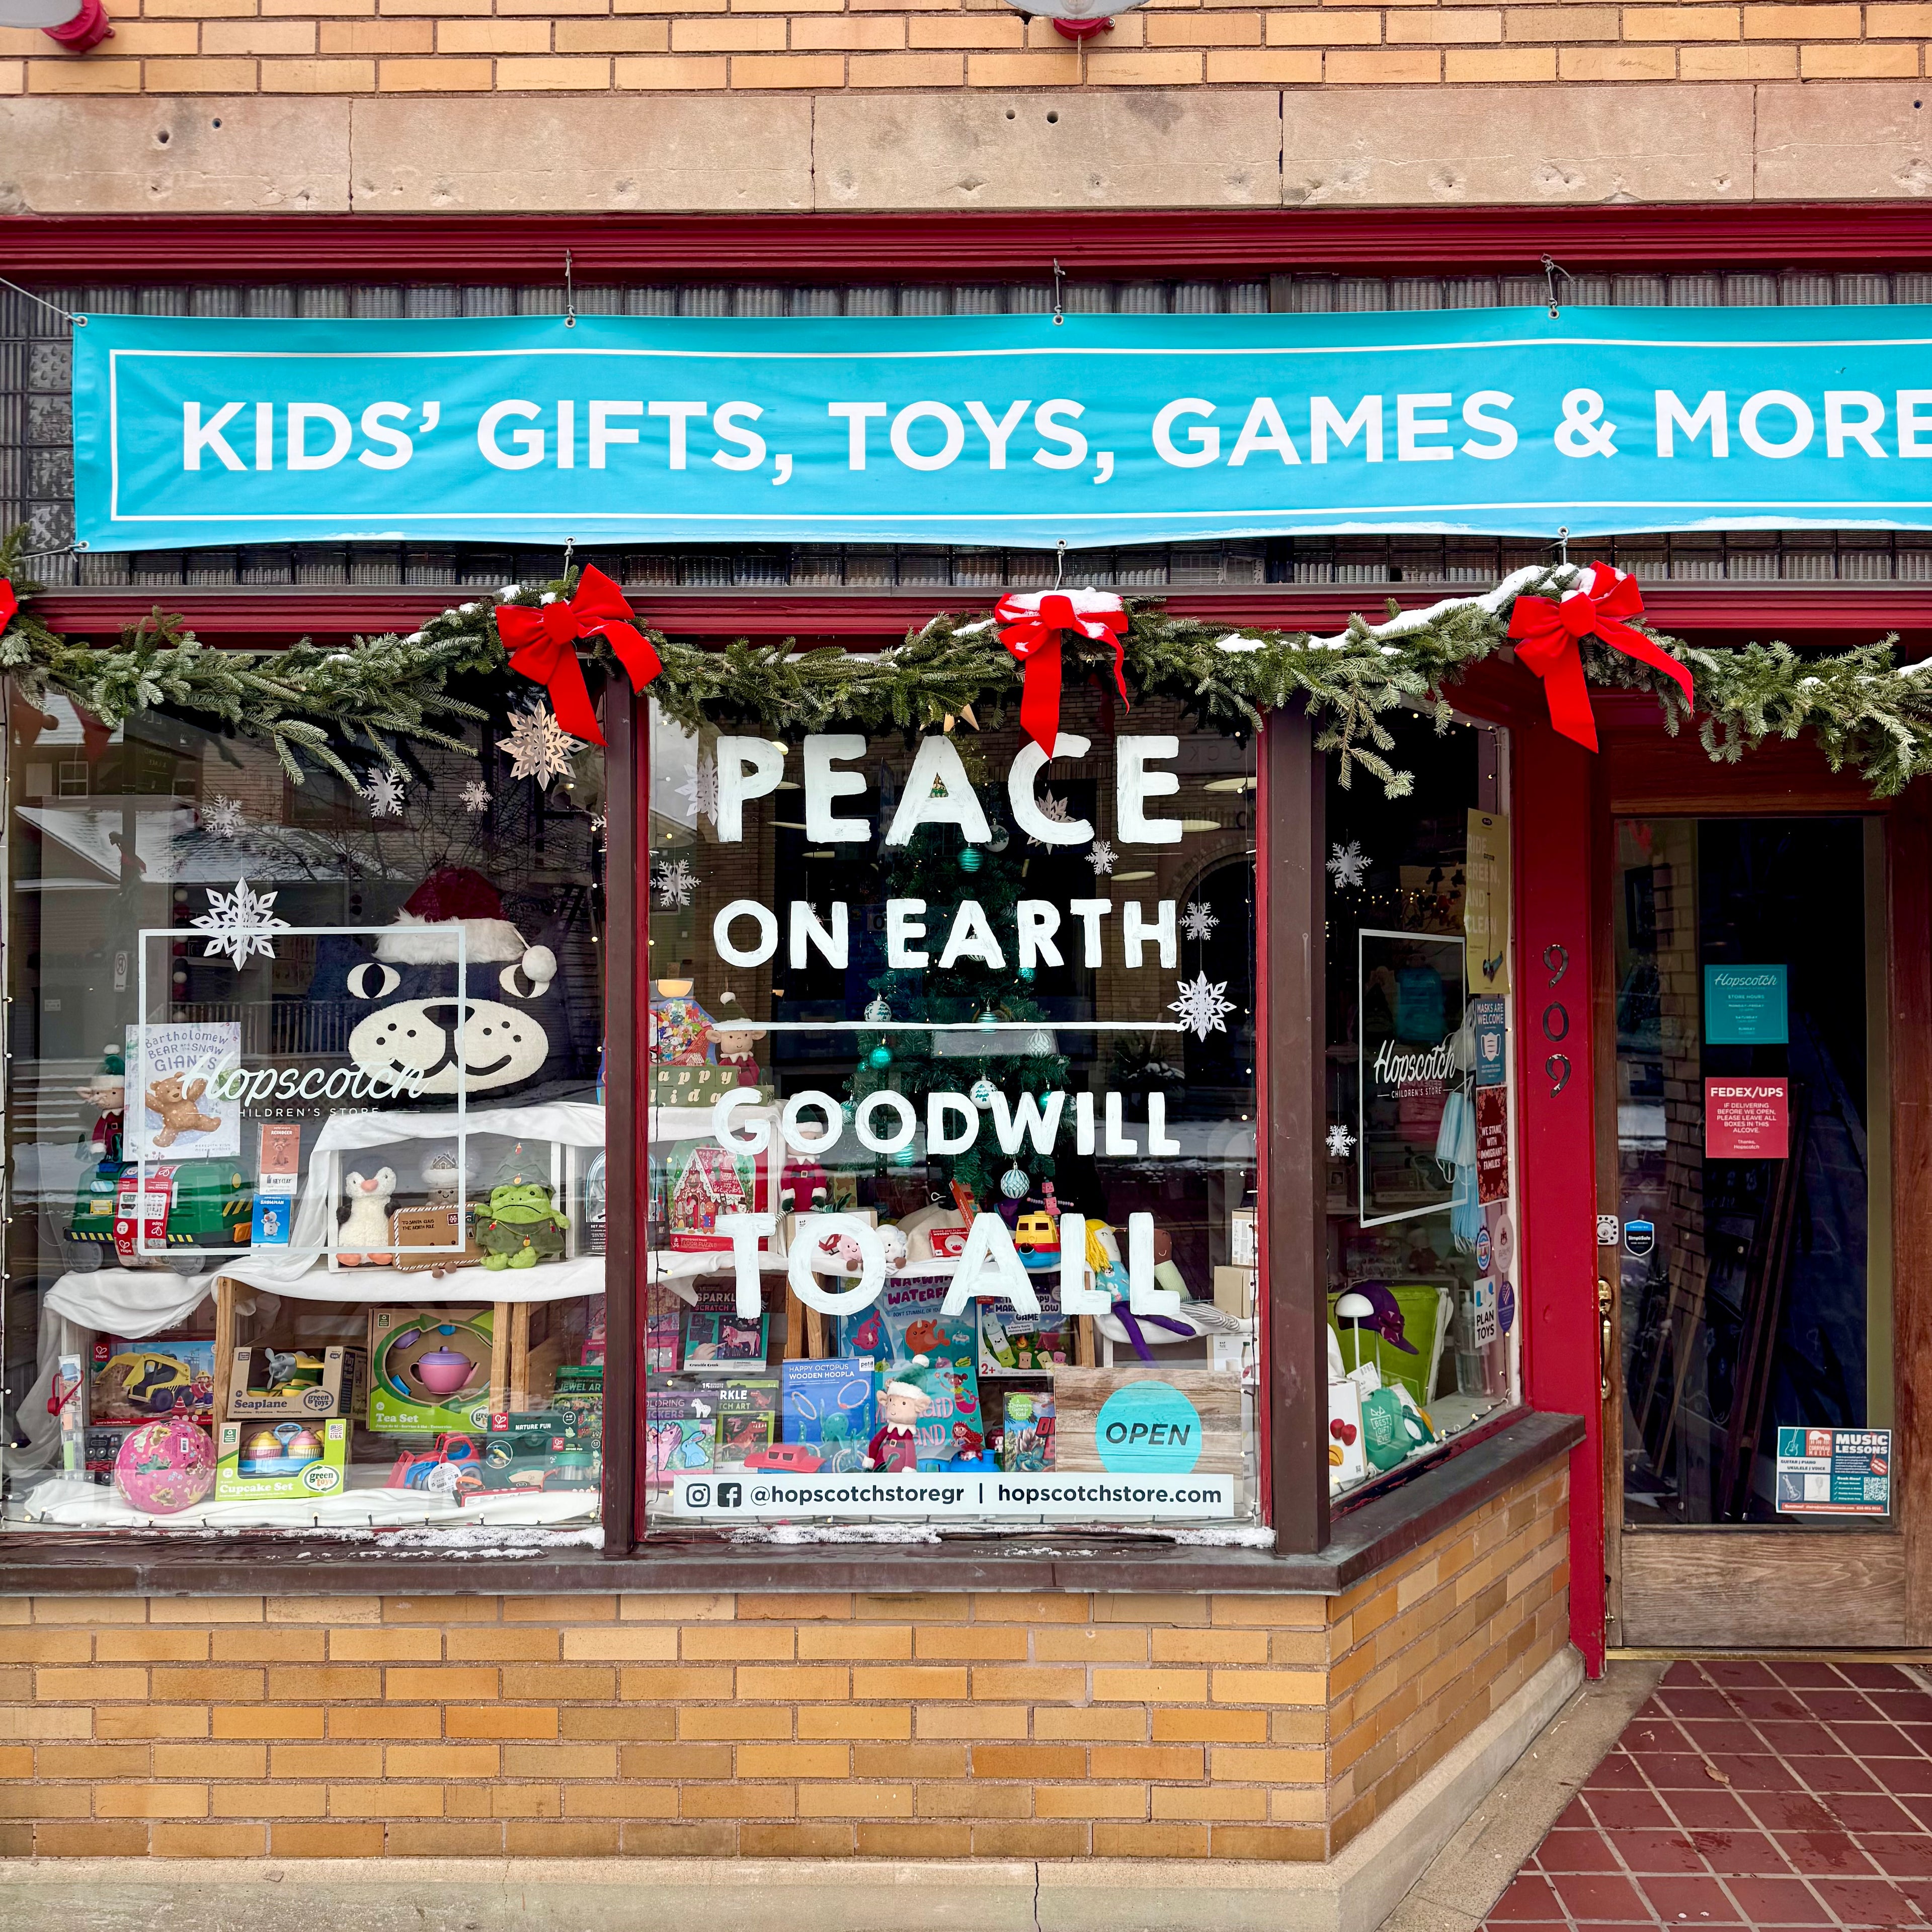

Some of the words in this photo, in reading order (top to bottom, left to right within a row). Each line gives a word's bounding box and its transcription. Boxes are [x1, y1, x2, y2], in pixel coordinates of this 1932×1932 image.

[476, 399, 794, 487] GIFTS,
[828, 397, 1116, 486] TOYS,
[1152, 389, 1516, 468] GAMES
[1554, 387, 1619, 458] &
[1655, 388, 1932, 459] MORE
[716, 732, 1183, 845] PEACE
[1467, 834, 1487, 855] RIDE
[1466, 861, 1501, 888] GREEN,
[1466, 889, 1485, 907] AND
[1465, 915, 1497, 935] CLEAN
[713, 899, 849, 970] ON
[886, 899, 1178, 970] EARTH
[1714, 973, 1778, 988] Hopscotch
[1477, 1003, 1493, 1013] MASKS
[1493, 1003, 1504, 1013] ARE
[1477, 1013, 1504, 1025] WELCOME
[145, 1029, 228, 1049] Bartholomew
[148, 1044, 179, 1059] BEAR
[191, 1043, 224, 1056] SNOW
[154, 1055, 217, 1072] GIANS
[1373, 1039, 1457, 1089] Hopscotch
[177, 1051, 431, 1107] Hopscotch
[1391, 1088, 1423, 1099] CHILDREN'S
[1425, 1087, 1442, 1095] STORE
[1710, 1086, 1784, 1099] FEDEX/UPS
[711, 1086, 1181, 1157] GOODWILL
[1481, 1126, 1488, 1137] WE
[1489, 1124, 1502, 1135] STAND
[1486, 1137, 1497, 1147] WITH
[1480, 1146, 1503, 1159] IMMIGRANT
[1483, 1158, 1501, 1171] FAMILIES
[714, 1212, 887, 1319] TO
[939, 1212, 1181, 1317] ALL
[1476, 1309, 1494, 1327] PLAN
[1476, 1324, 1495, 1341] TOYS
[815, 1363, 849, 1372] OCTOPUS
[981, 1362, 996, 1375] 2+
[824, 1371, 855, 1379] HOOPLA
[558, 1383, 587, 1392] JEWEL
[234, 1399, 288, 1409] Seaplane
[307, 1395, 329, 1404] green
[375, 1413, 397, 1423] Tea
[399, 1413, 419, 1423] Set
[1375, 1418, 1390, 1427] BEST
[1105, 1422, 1191, 1446] OPEN
[1377, 1425, 1390, 1434] GIFT
[1835, 1433, 1889, 1446] MUSIC
[1835, 1444, 1888, 1455] LESSONS
[309, 1472, 334, 1483] green
[316, 1478, 334, 1487] toys
[219, 1484, 272, 1494] Cupcake
[274, 1482, 294, 1492] Set
[750, 1485, 965, 1506] @hopscotchstoregr
[998, 1484, 1222, 1505] hopscotchstore.com
